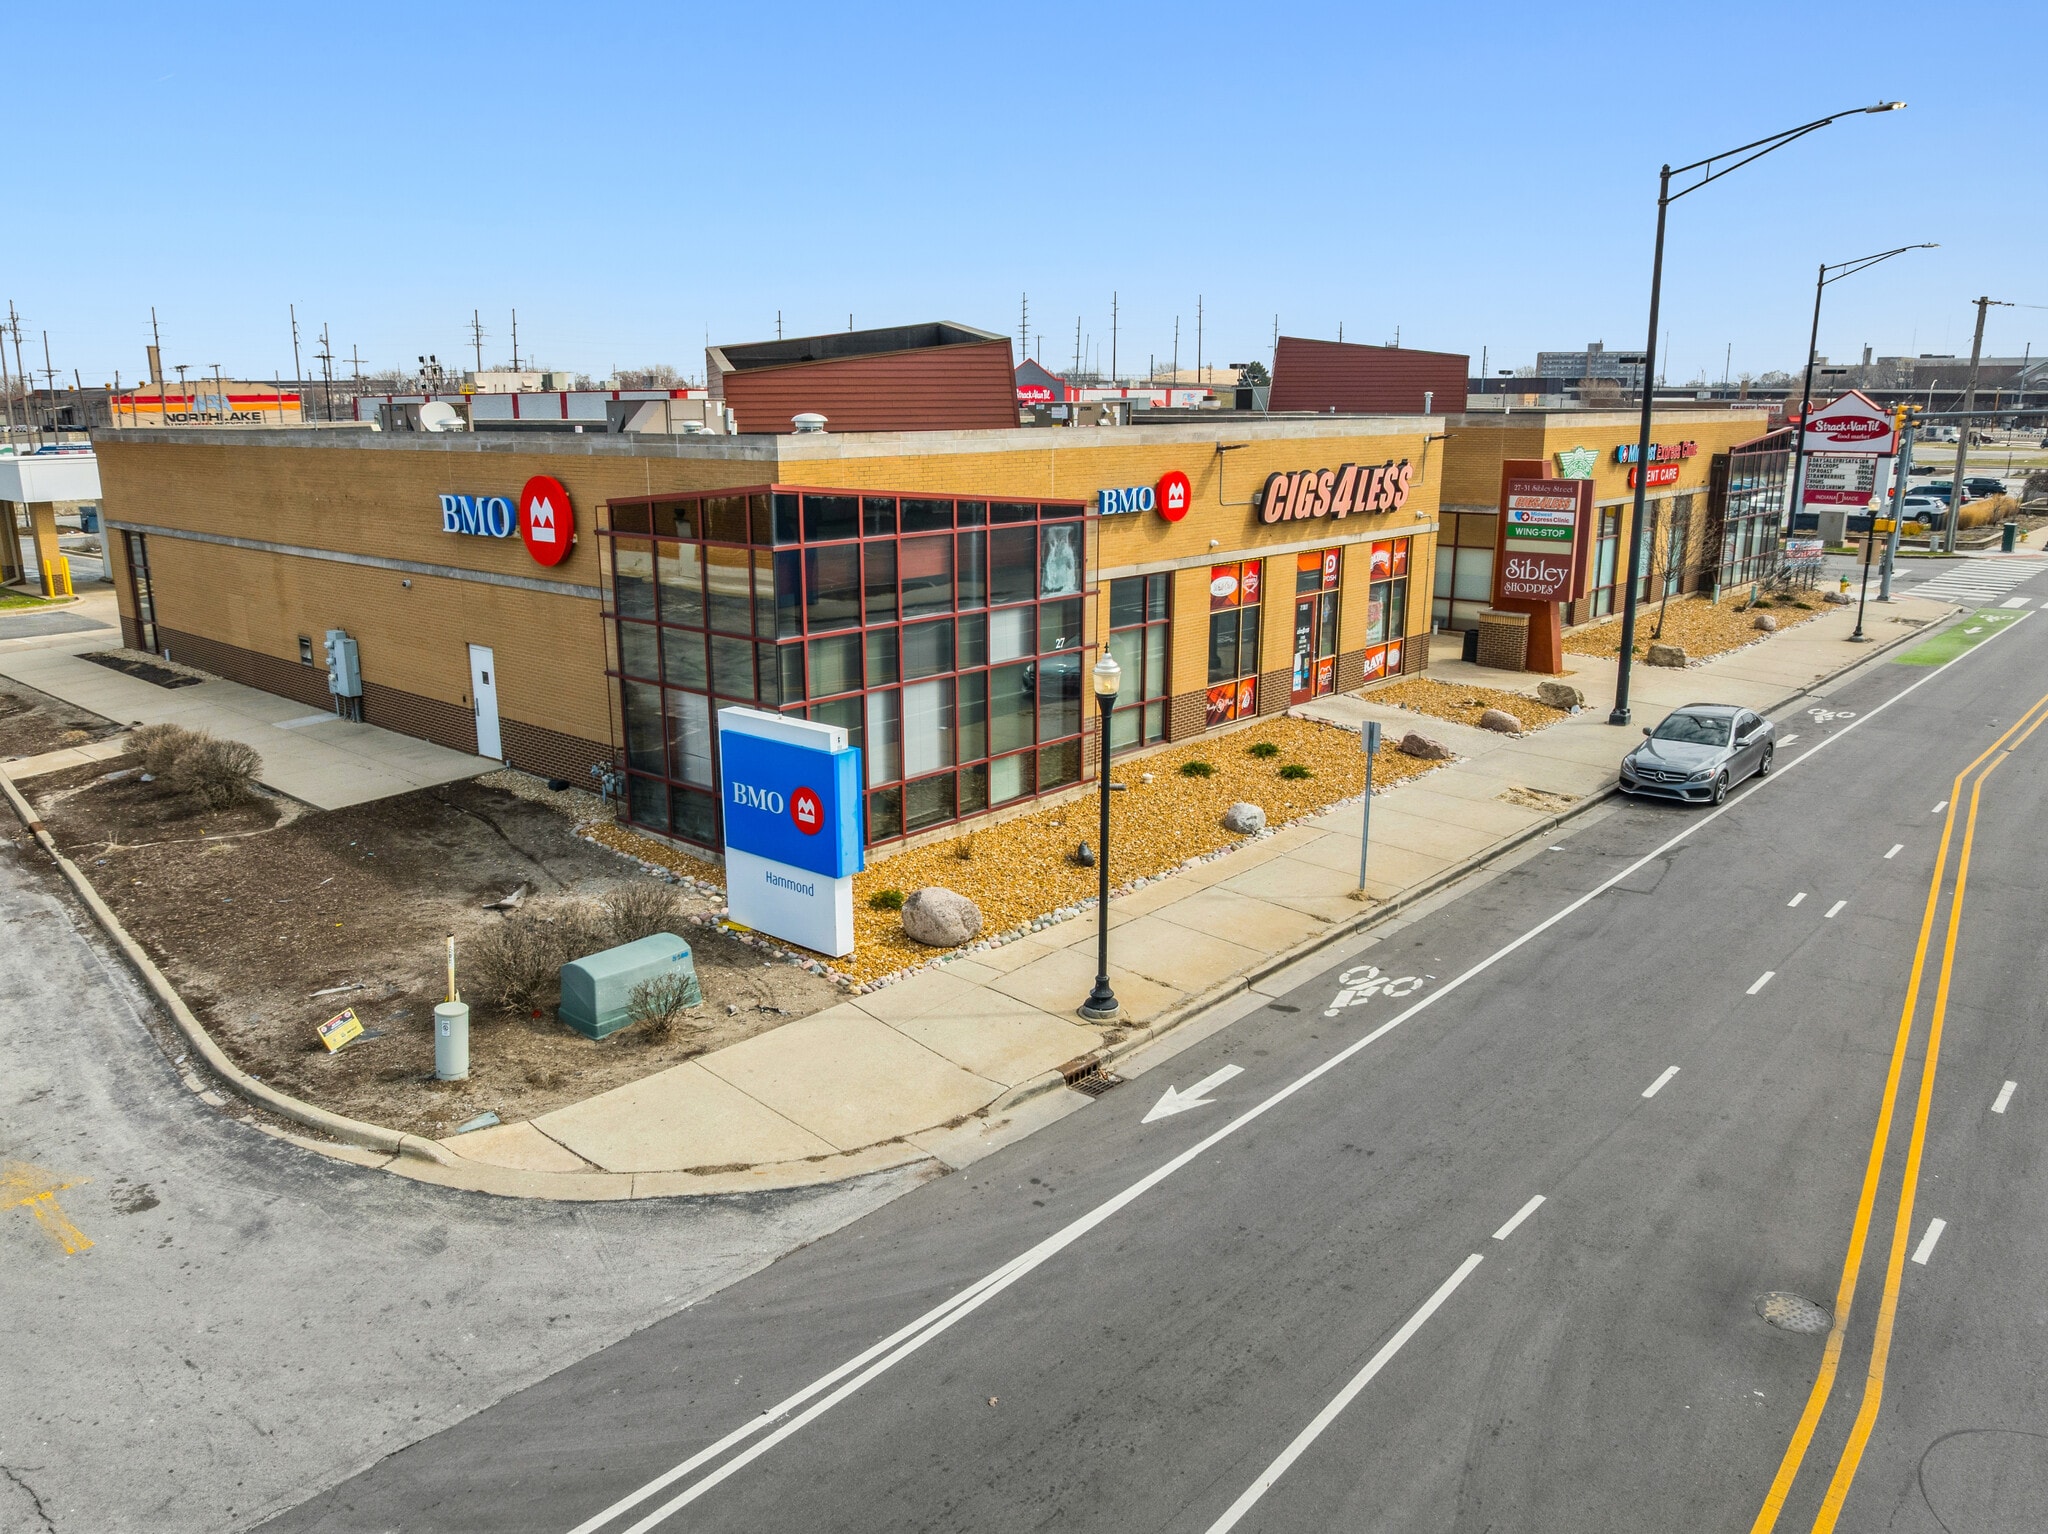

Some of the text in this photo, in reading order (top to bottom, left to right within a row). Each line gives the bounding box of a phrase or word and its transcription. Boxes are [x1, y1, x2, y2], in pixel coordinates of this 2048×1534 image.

[166, 412, 261, 422] NORTHLAKE
[1815, 420, 1847, 432] Strack
[1850, 420, 1867, 432] Van
[1867, 420, 1880, 432] Til
[1656, 443, 1681, 463] Express
[1660, 467, 1677, 481] CARE
[1513, 484, 1573, 493] 27-31 Sibley Street
[1100, 486, 1156, 515] BMO
[438, 494, 514, 538] BMO
[1515, 527, 1566, 537] WING-STOP
[1505, 558, 1569, 589] Sibley
[1504, 582, 1554, 595] SHOPPES
[1055, 637, 1065, 649] 27
[1363, 650, 1386, 673] RAW
[731, 781, 784, 815] BMO
[765, 870, 815, 897] Hammond
